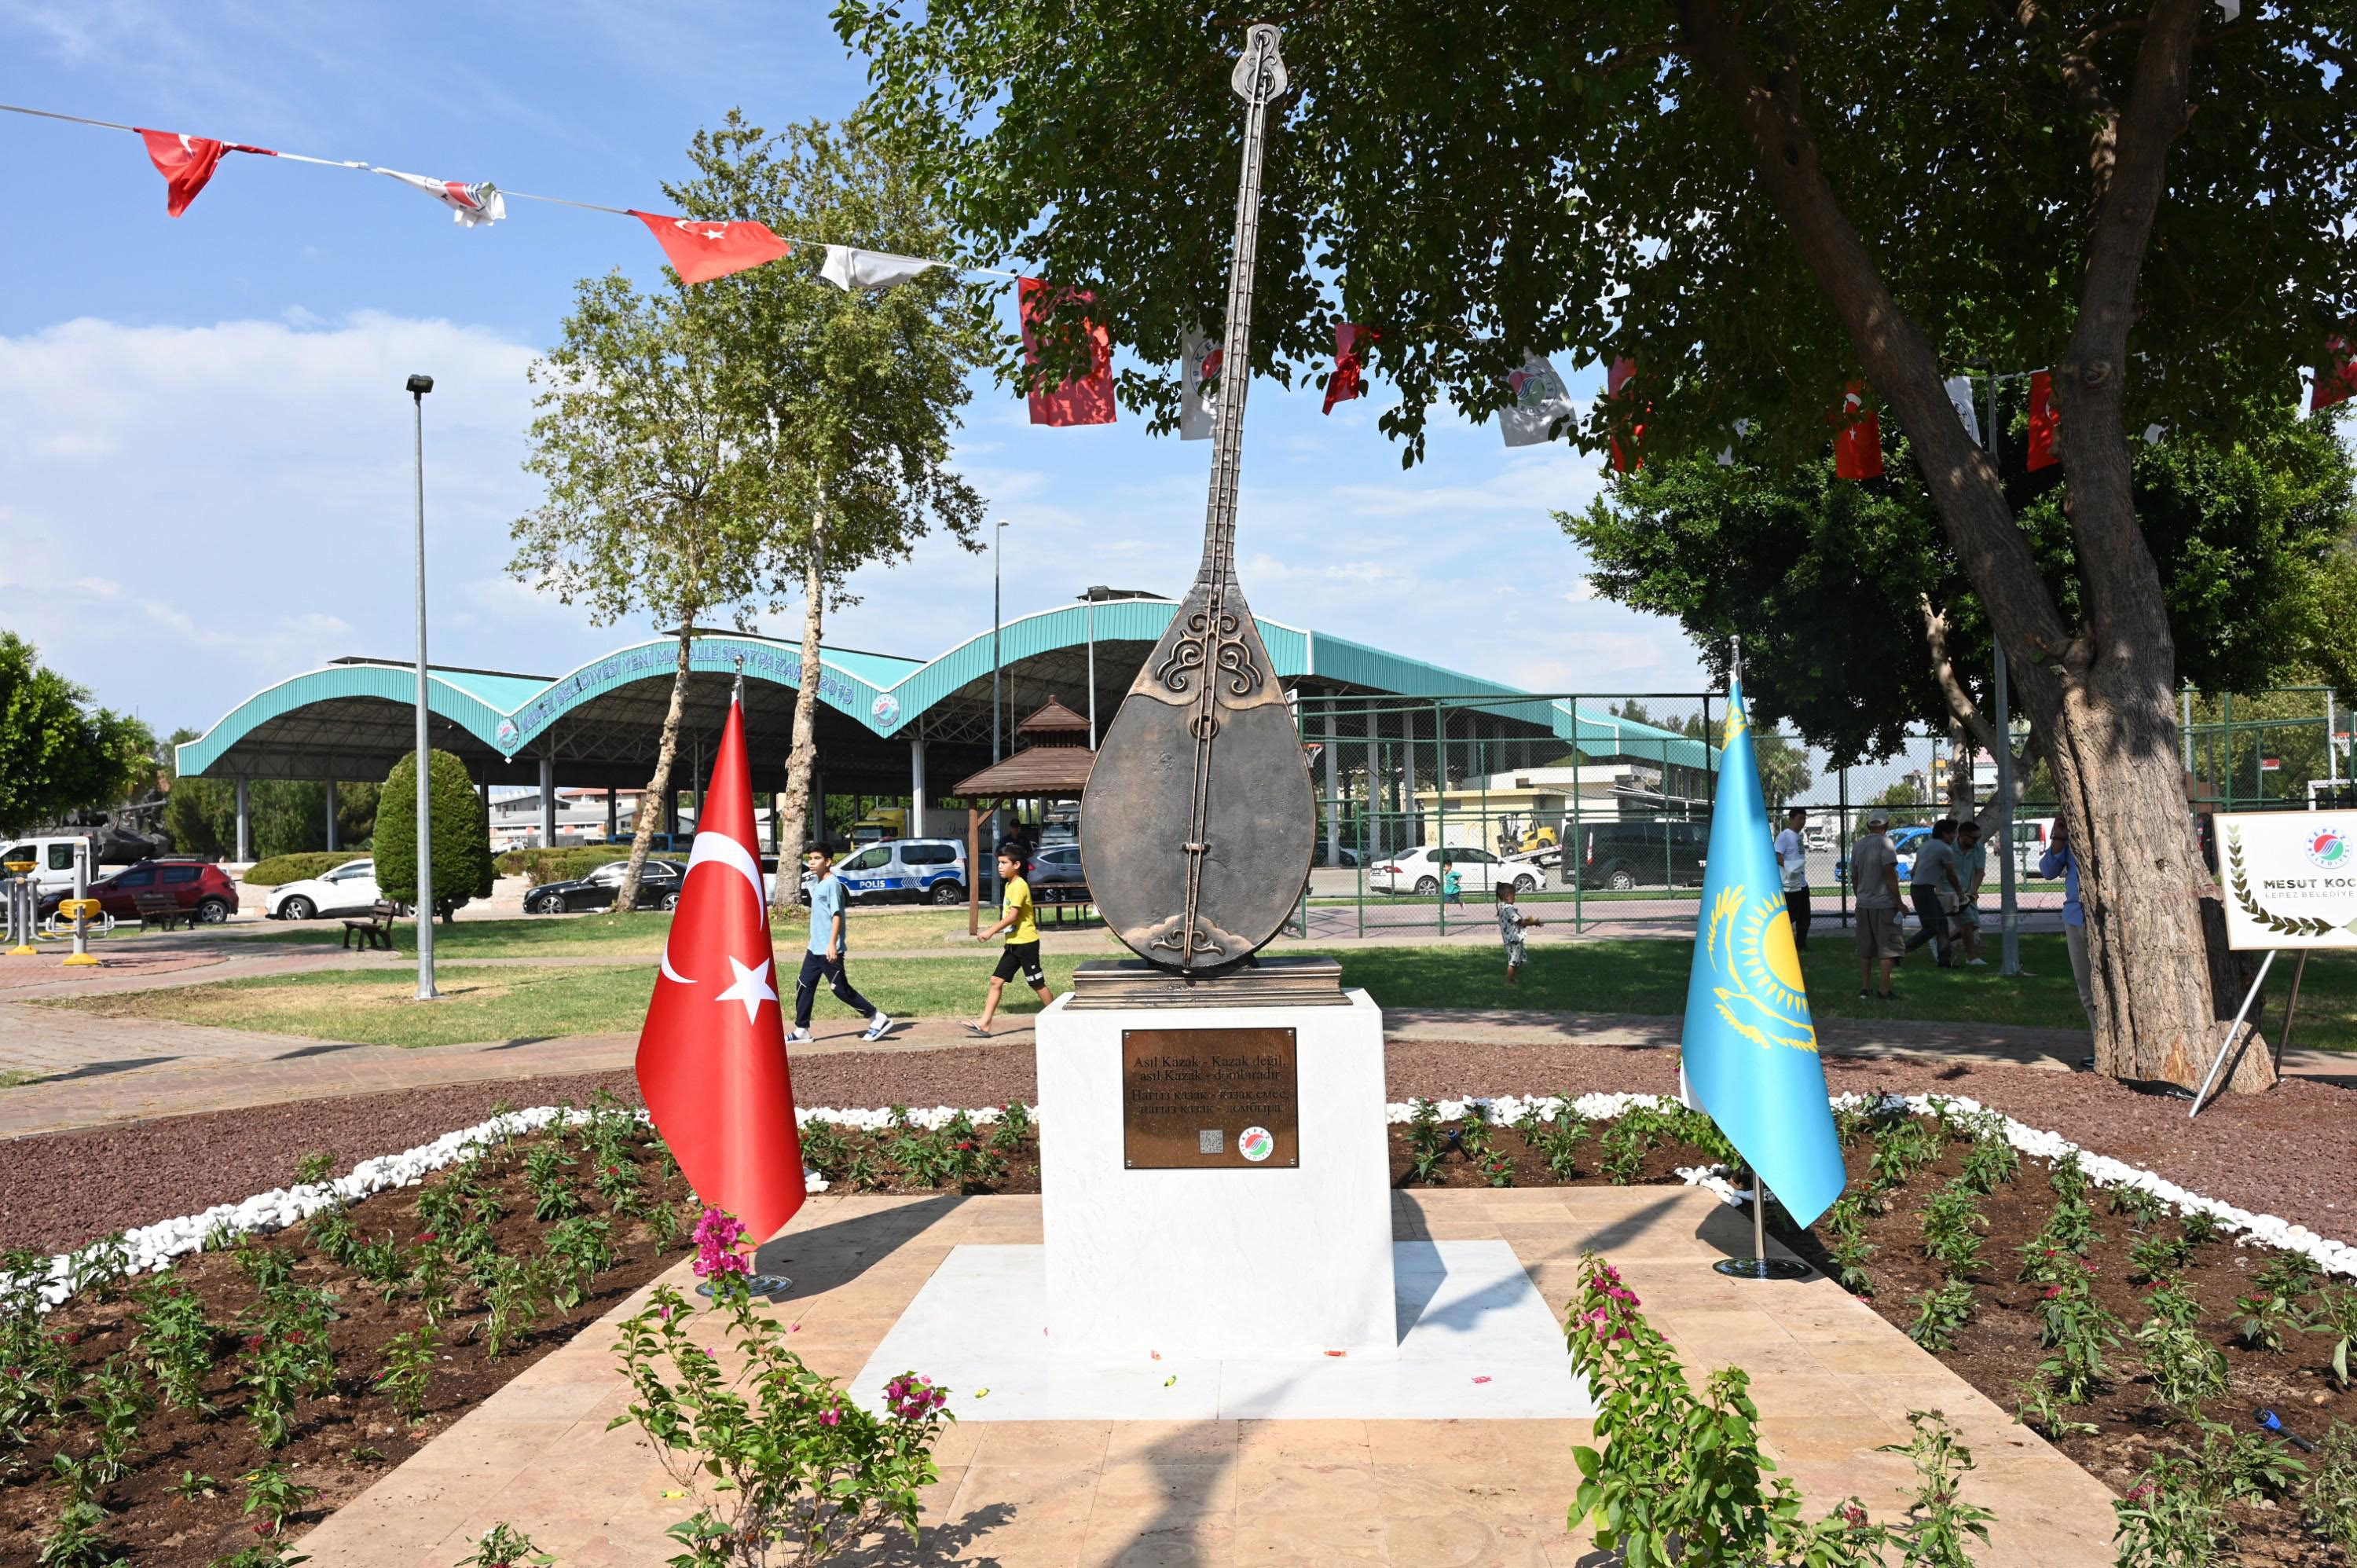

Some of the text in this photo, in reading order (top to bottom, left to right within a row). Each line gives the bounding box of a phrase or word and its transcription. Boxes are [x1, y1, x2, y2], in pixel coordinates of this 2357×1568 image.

[621, 647, 654, 673] YENİ
[657, 644, 718, 665] MAALLE
[721, 644, 759, 665] SEMT
[757, 650, 802, 682] PAZAR
[818, 674, 854, 705] 2013
[859, 880, 886, 889] POLİS
[2264, 877, 2357, 889] MESUT KOC
[1134, 1057, 1157, 1068] Asıl
[1163, 1056, 1199, 1068] Kazak
[1212, 1056, 1248, 1067] Kazak
[1140, 1070, 1161, 1081] asıl
[1165, 1070, 1201, 1081] Kazak
